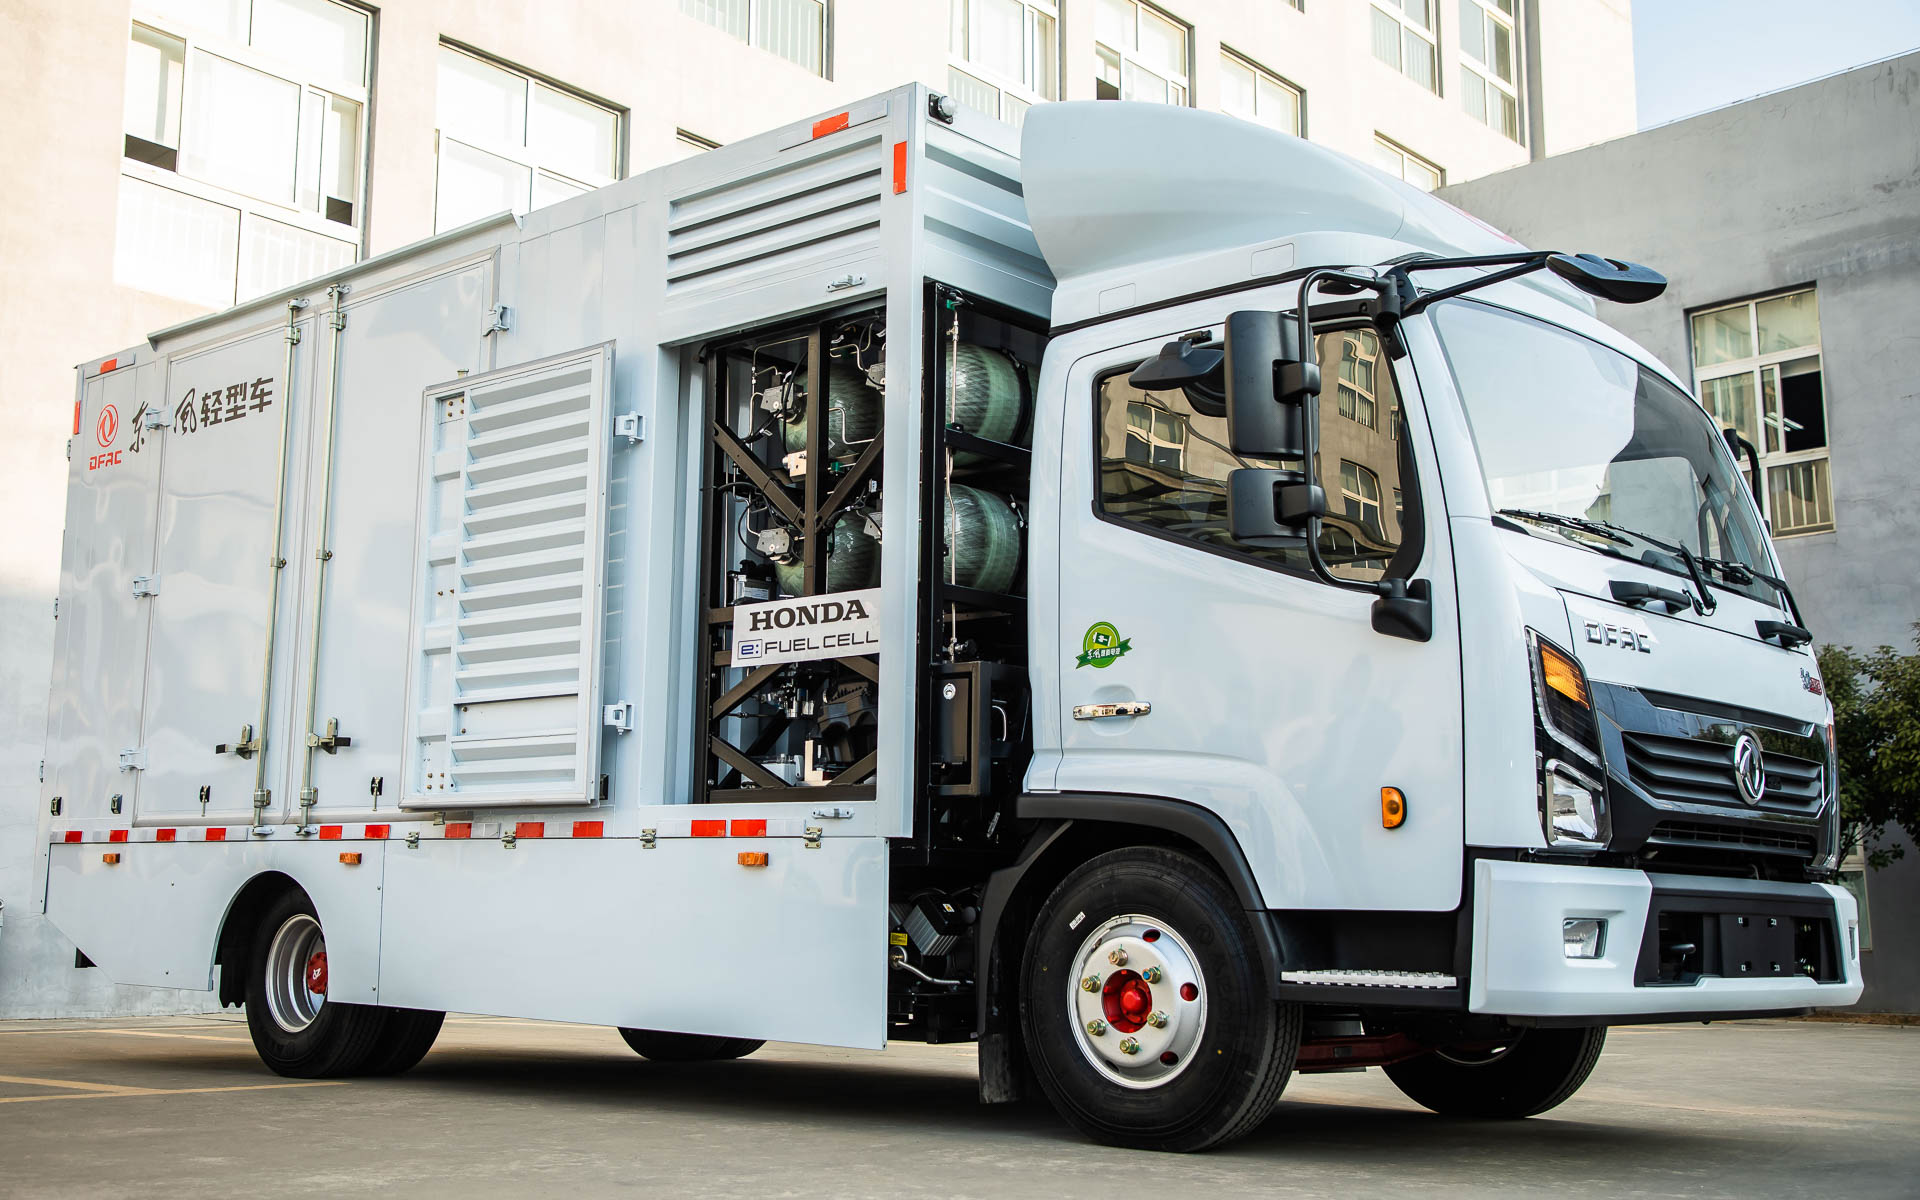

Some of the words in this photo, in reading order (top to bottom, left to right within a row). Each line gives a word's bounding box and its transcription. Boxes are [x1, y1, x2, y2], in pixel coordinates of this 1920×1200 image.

[89, 450, 123, 471] DFAC
[749, 599, 870, 632] HONDA
[764, 637, 820, 655] FUEL
[823, 631, 879, 648] CELL
[1583, 620, 1651, 654] DFAC
